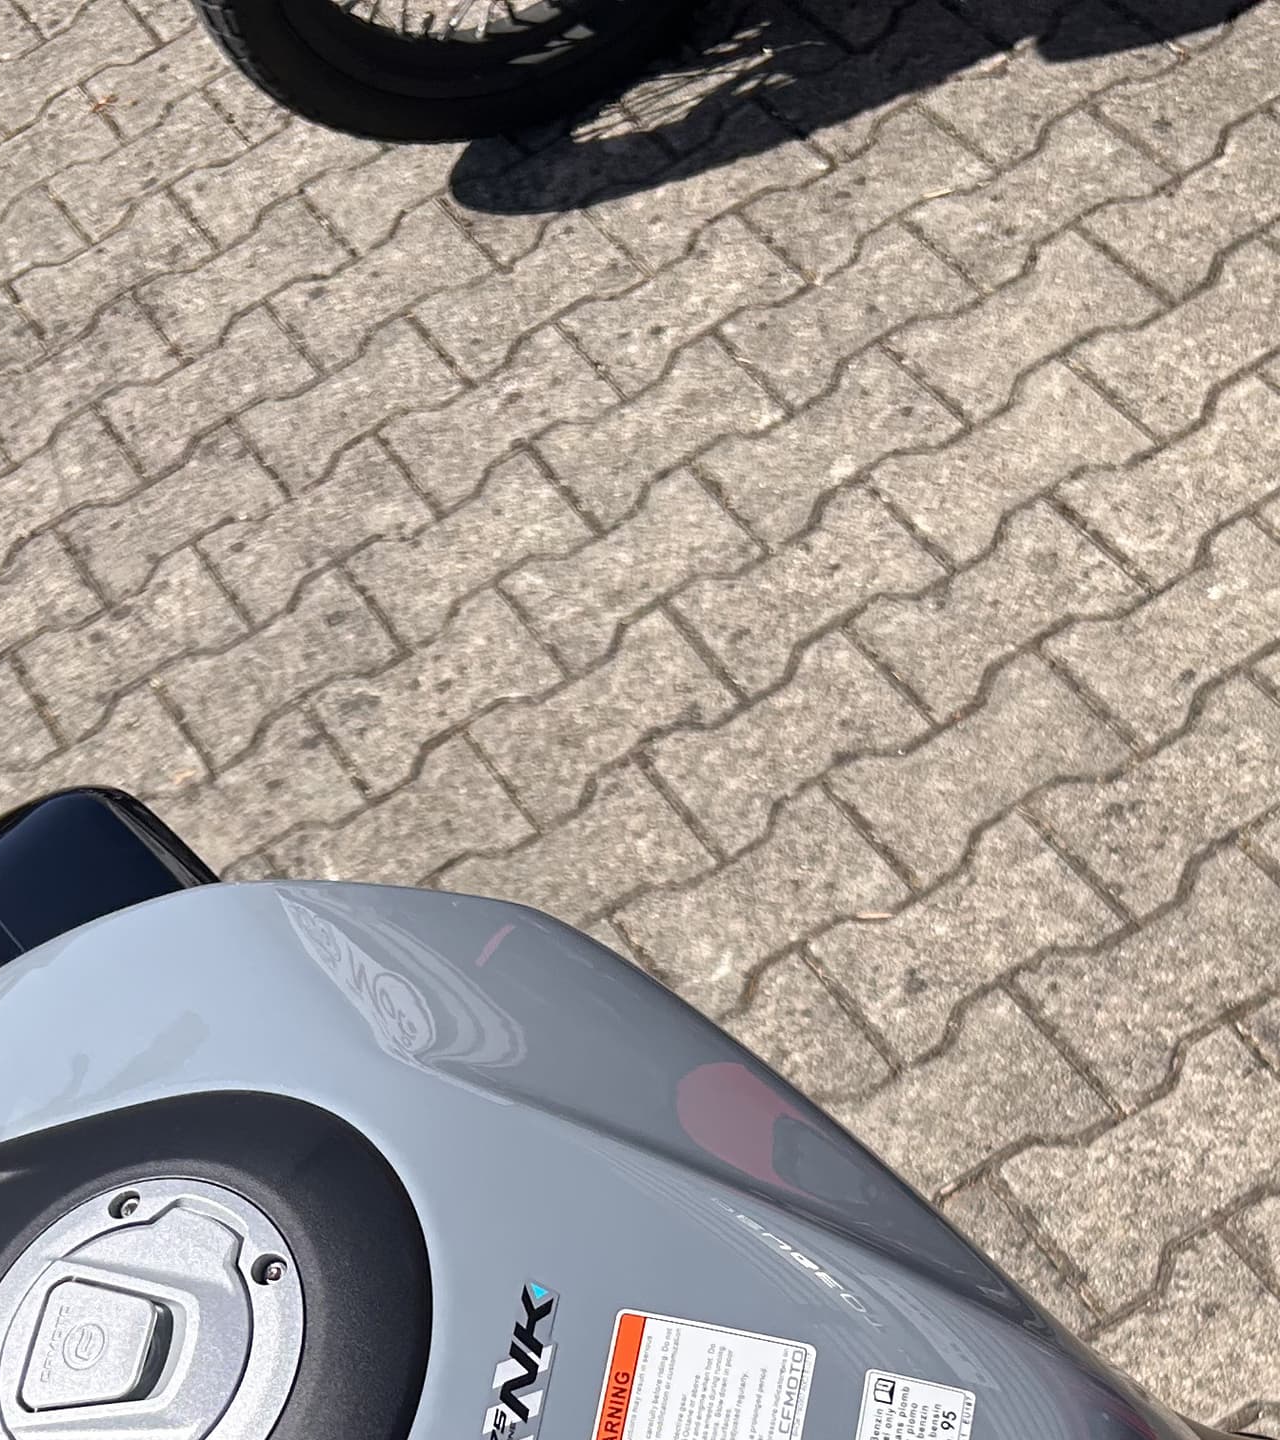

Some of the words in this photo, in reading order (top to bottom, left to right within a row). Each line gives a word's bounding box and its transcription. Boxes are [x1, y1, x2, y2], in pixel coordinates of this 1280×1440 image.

[495, 1283, 556, 1423] NK
[778, 1349, 804, 1434] CFMOTO
[898, 1385, 912, 1417] plomb
[885, 1407, 897, 1429] only
[906, 1402, 920, 1434] plomo
[916, 1404, 929, 1438] benzin
[929, 1403, 941, 1437] bensin
[940, 1409, 957, 1432] 95
